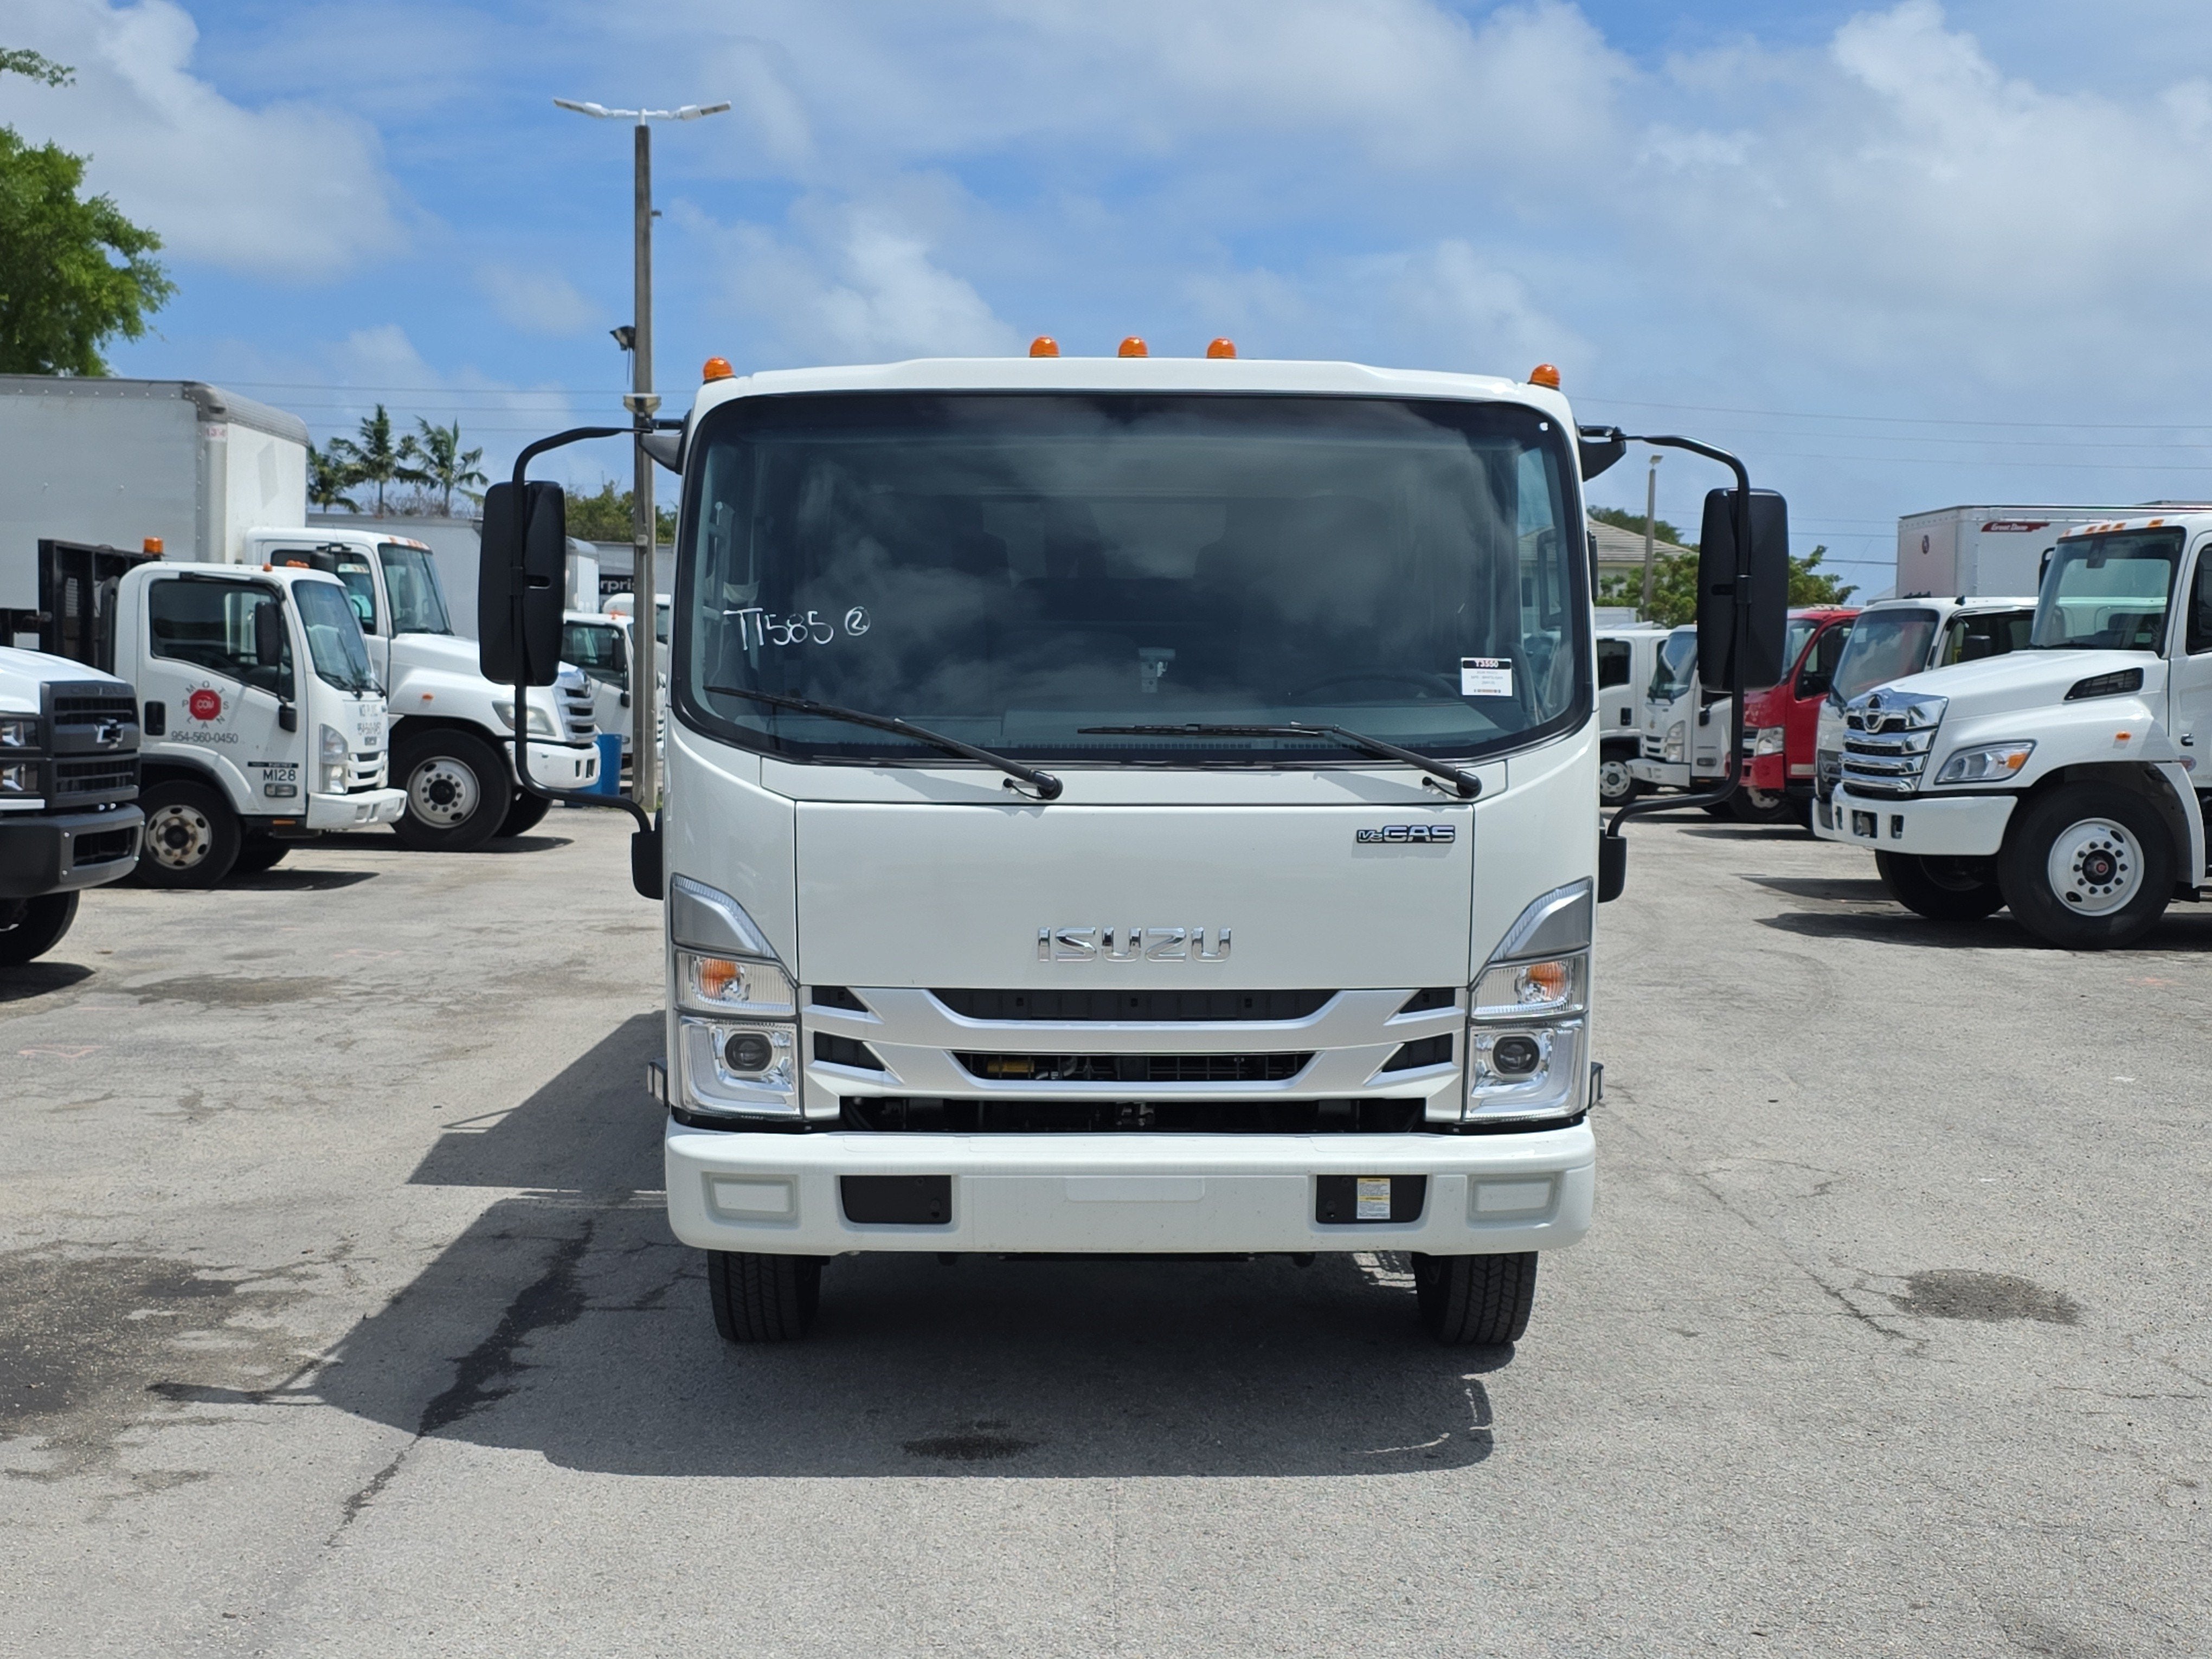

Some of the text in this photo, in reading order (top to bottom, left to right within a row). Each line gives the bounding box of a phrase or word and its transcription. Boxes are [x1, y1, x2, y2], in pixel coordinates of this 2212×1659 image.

[171, 730, 239, 743] 954-560-0450
[263, 769, 297, 781] M128
[1038, 927, 1232, 963] ISUZU
